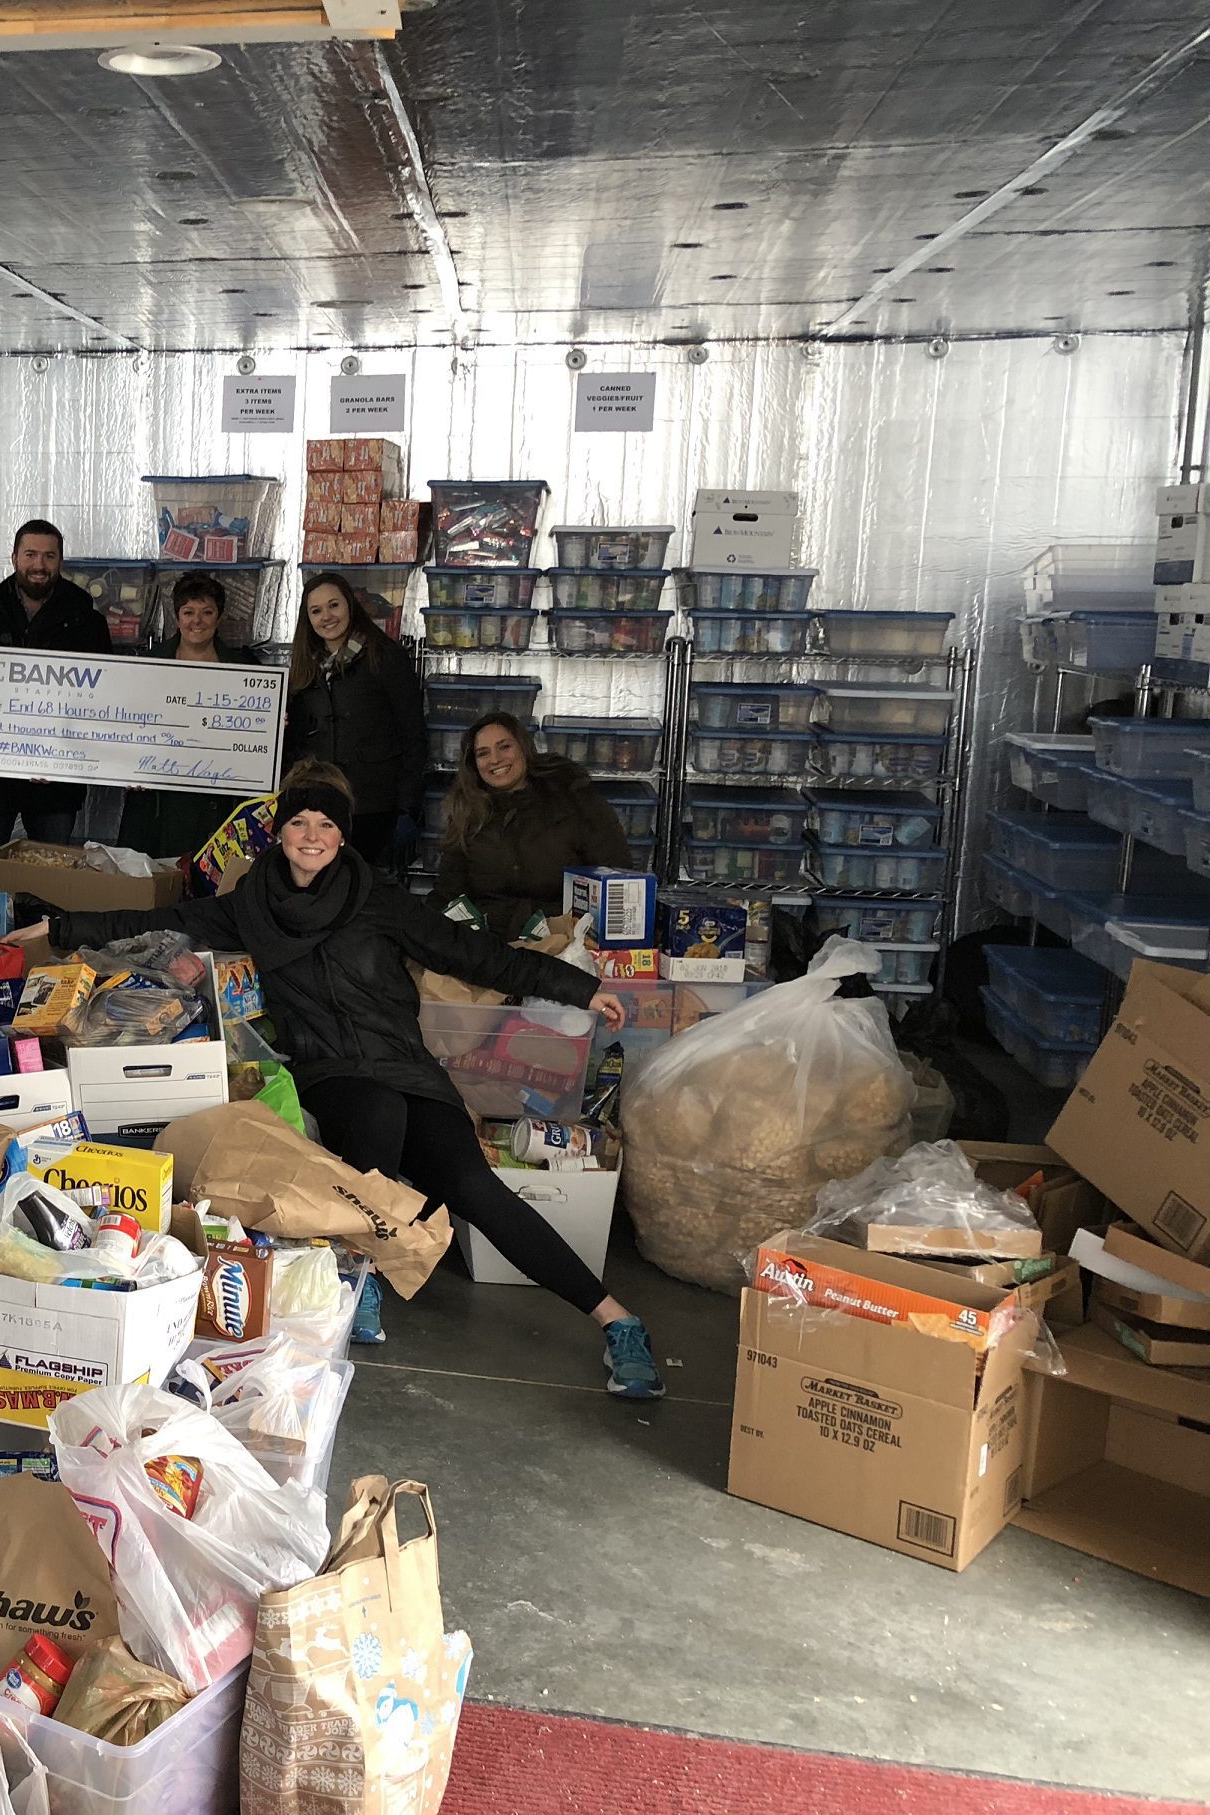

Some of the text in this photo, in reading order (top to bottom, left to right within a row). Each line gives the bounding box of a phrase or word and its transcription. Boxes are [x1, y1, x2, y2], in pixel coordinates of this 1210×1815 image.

[8, 661, 103, 689] BANKW
[242, 678, 277, 690] 10735
[14, 687, 94, 699] STAFFING
[166, 695, 187, 705] DATE
[9, 698, 162, 729] End 68 Hours of Hunger
[202, 717, 208, 727] $
[8, 723, 56, 736] thousand
[62, 727, 89, 739] three
[91, 728, 133, 742] hundred
[136, 734, 156, 743] and
[232, 743, 268, 754] DOLLARS
[679, 910, 690, 925] 5
[640, 954, 652, 967] 18
[53, 1120, 71, 1137] 18
[76, 1145, 124, 1158] Cheerios
[217, 1255, 244, 1338] Minute
[824, 1288, 899, 1318] Peanut Butter
[958, 1309, 977, 1325] 45
[15, 1355, 103, 1378] FLAGSHIP
[746, 1350, 778, 1368] 971043
[15, 1364, 103, 1386] Premium Copy Paper
[805, 1381, 853, 1402] MARKET
[855, 1394, 898, 1416] BASKET
[808, 1397, 891, 1430] APPLE CINNAMON
[740, 1424, 754, 1436] BEST
[796, 1405, 902, 1448] TOASTED OATS CEREAL
[819, 1425, 876, 1452] 10 X 12.9 OZ
[5, 1622, 16, 1631] for
[18, 1625, 59, 1640] something
[279, 1722, 317, 1736] TRADER
